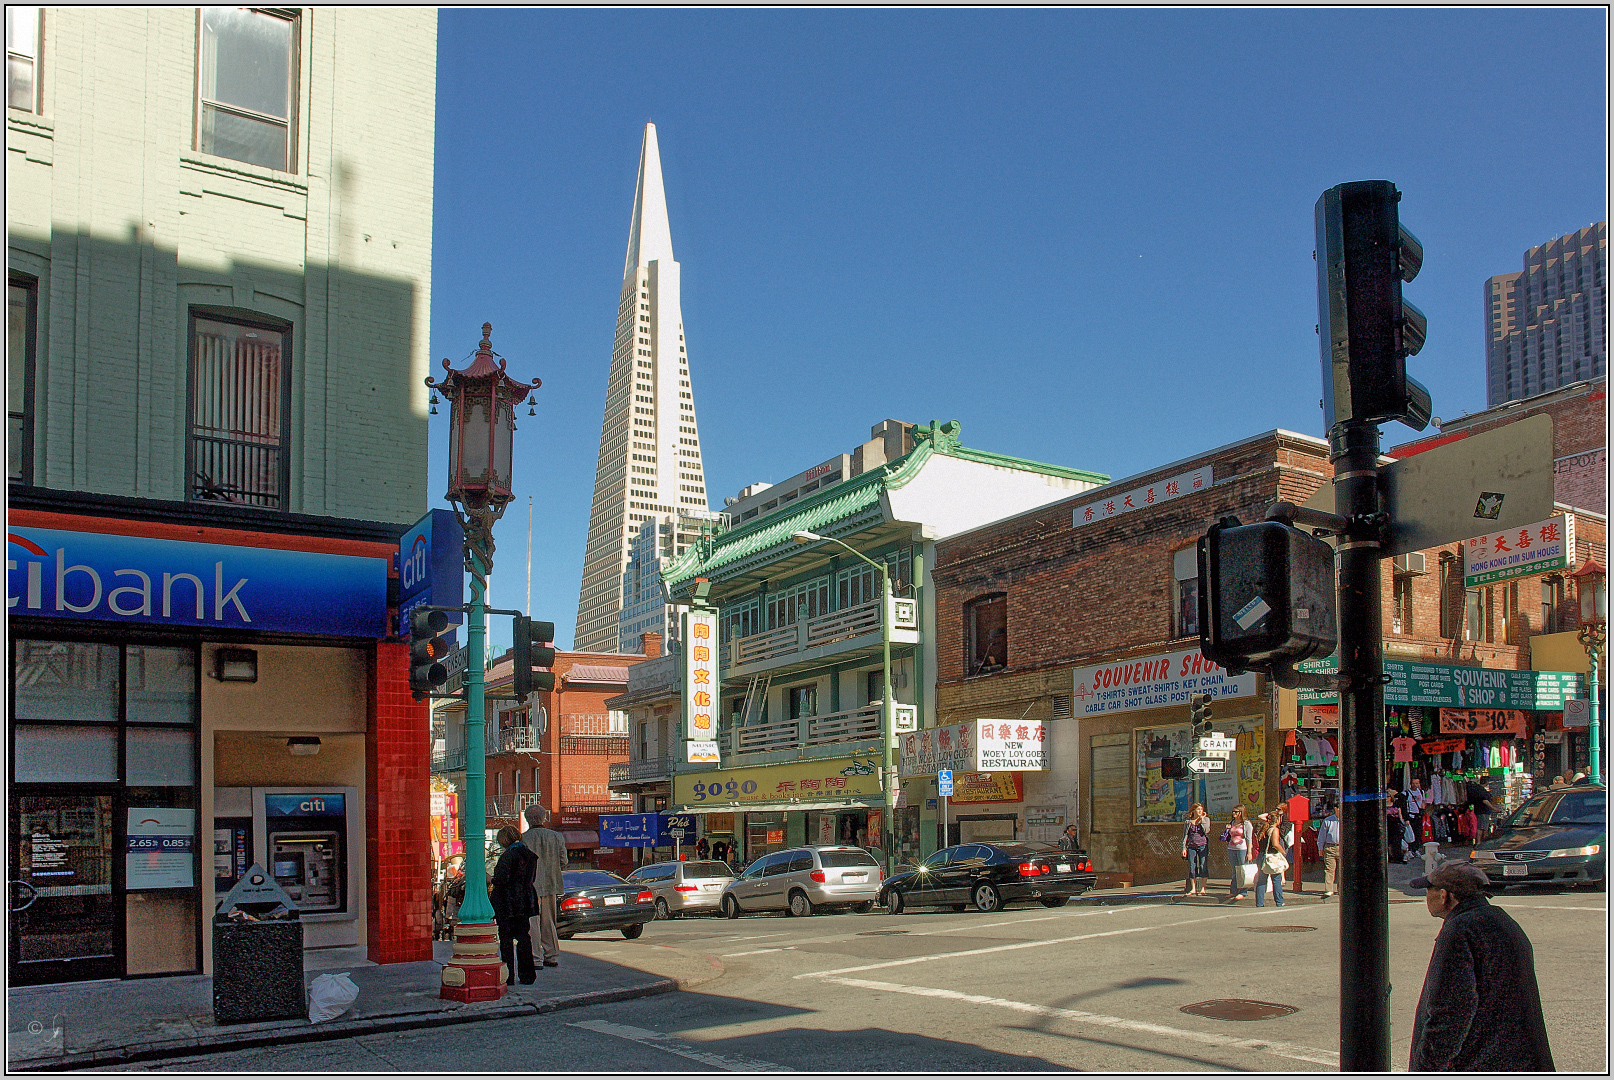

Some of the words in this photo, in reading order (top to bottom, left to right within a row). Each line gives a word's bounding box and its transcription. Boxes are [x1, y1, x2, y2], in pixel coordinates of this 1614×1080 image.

[806, 464, 832, 481] Hilton
[1083, 480, 1180, 521] 香港天喜樓
[1494, 523, 1561, 554] 天喜樓
[403, 544, 427, 590] citi
[1470, 561, 1488, 572] HONG
[1489, 556, 1507, 568] KONG
[1508, 553, 1520, 565] DIM
[1521, 550, 1536, 562] SUM
[1537, 545, 1560, 558] HOUSE
[8, 547, 252, 622] ibank
[1303, 659, 1331, 669] SHIRTS
[694, 623, 711, 729] 陶陶文化城
[1093, 658, 1170, 690] SOUVENIR
[1453, 669, 1508, 689] SOUVENIR
[1096, 690, 1126, 701] T-SHIRTS
[1128, 681, 1180, 696] SWEAT-SHIRTS
[1182, 678, 1198, 689] KEY
[1201, 675, 1224, 686] CHAIN
[1320, 691, 1338, 699] CAPS
[1468, 688, 1495, 705] SHOP
[1085, 702, 1106, 713] CABLE
[1107, 700, 1121, 710] CAR
[1124, 697, 1142, 707] SHOT
[1145, 693, 1168, 705] GLASS
[1170, 690, 1190, 701] POST
[1221, 684, 1239, 695] MUG
[1313, 715, 1322, 724] 5
[1467, 711, 1478, 731] 5
[981, 723, 1047, 742] 同樂飯店
[1004, 741, 1024, 749] NEW
[1203, 740, 1233, 748] GRANT
[938, 750, 954, 761] LOY
[953, 748, 975, 760] GOEY
[982, 750, 1007, 758] WOEY
[1009, 750, 1025, 758] LOY
[1025, 750, 1047, 758] GOEY
[912, 759, 966, 775] RESTAURANT
[981, 758, 1048, 768] RESTAURANT
[1198, 761, 1210, 769] ONE
[693, 777, 757, 801] gogo
[962, 786, 1002, 795] RESTAURANT
[300, 800, 326, 812] citi
[129, 839, 152, 847] 2.65
[162, 839, 184, 847] 0.85
